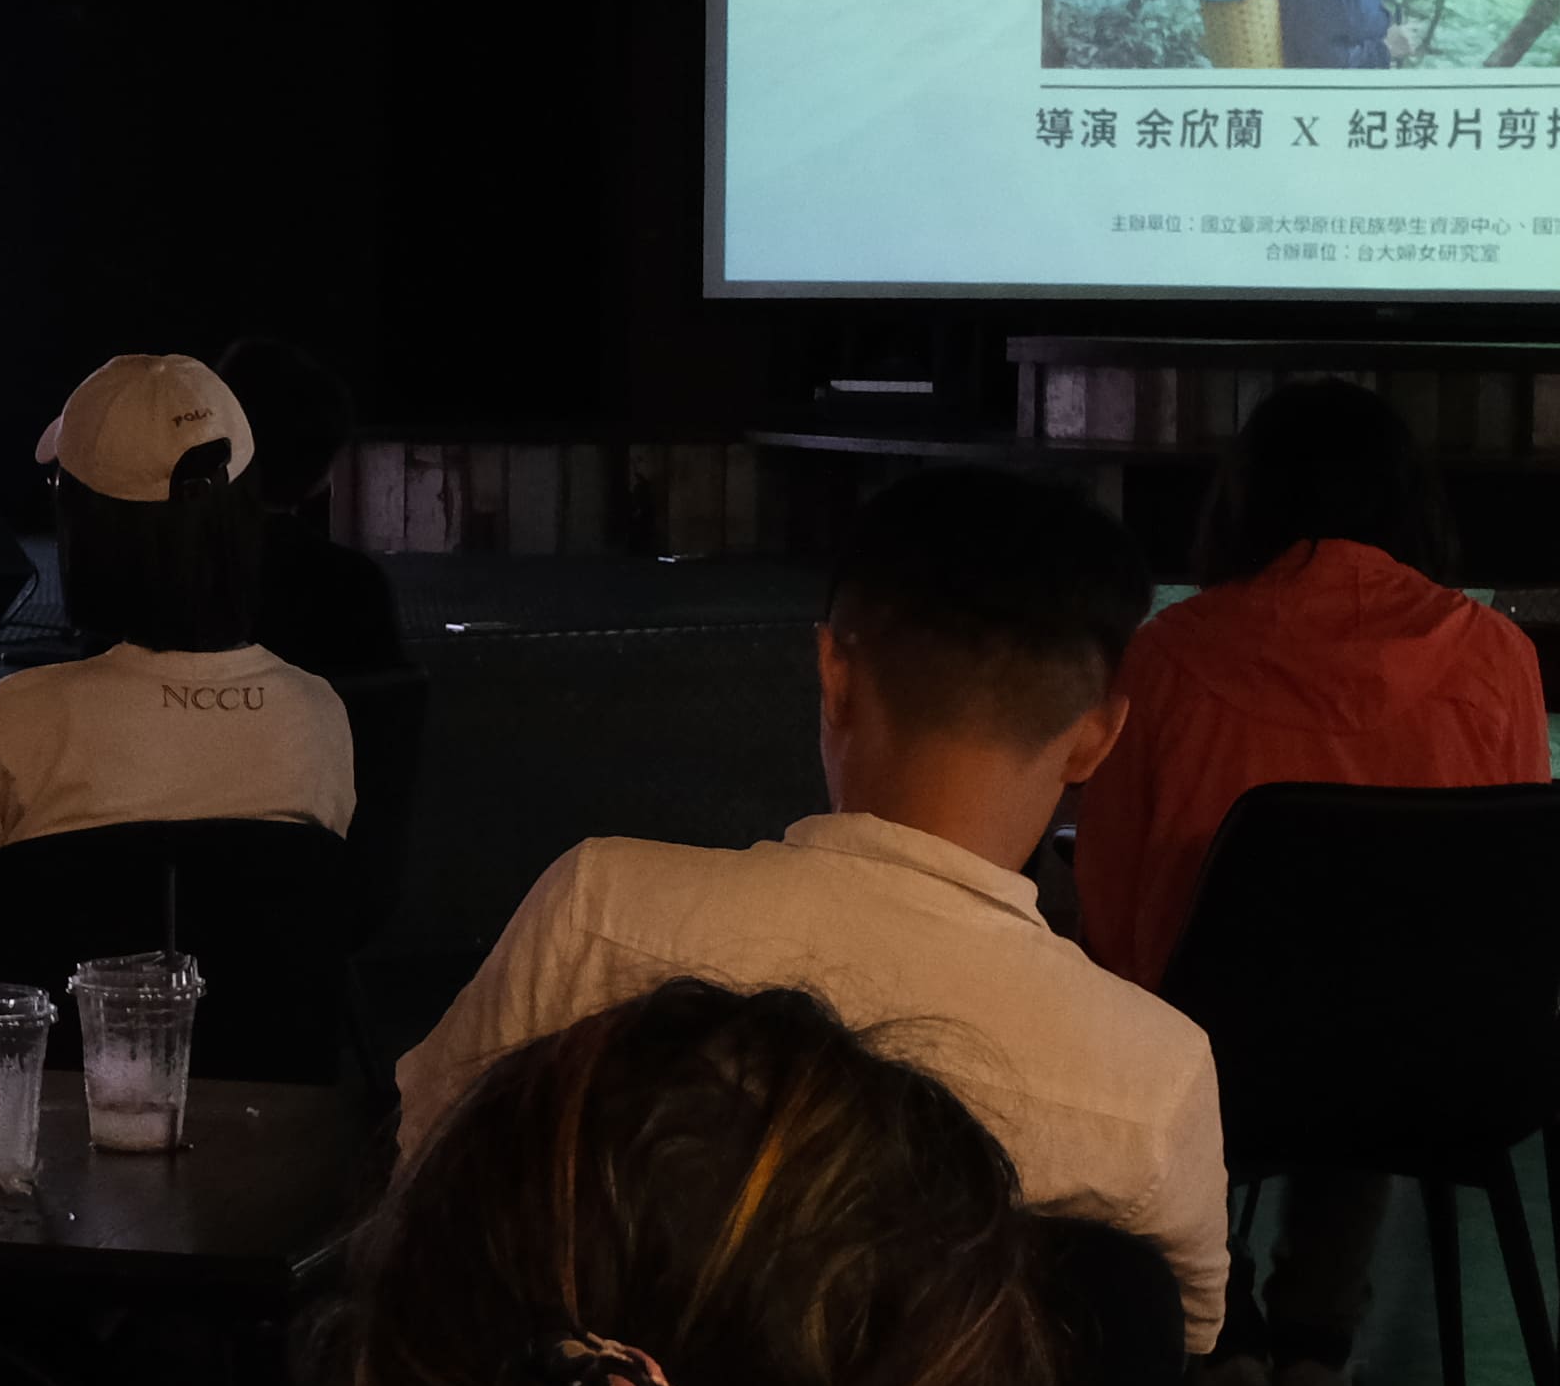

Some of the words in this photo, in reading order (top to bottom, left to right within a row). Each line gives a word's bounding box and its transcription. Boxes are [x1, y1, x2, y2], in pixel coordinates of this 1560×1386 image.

[1035, 107, 1118, 149] 導演
[1135, 108, 1264, 149] 余欣蘭
[161, 684, 264, 711] NCCU
